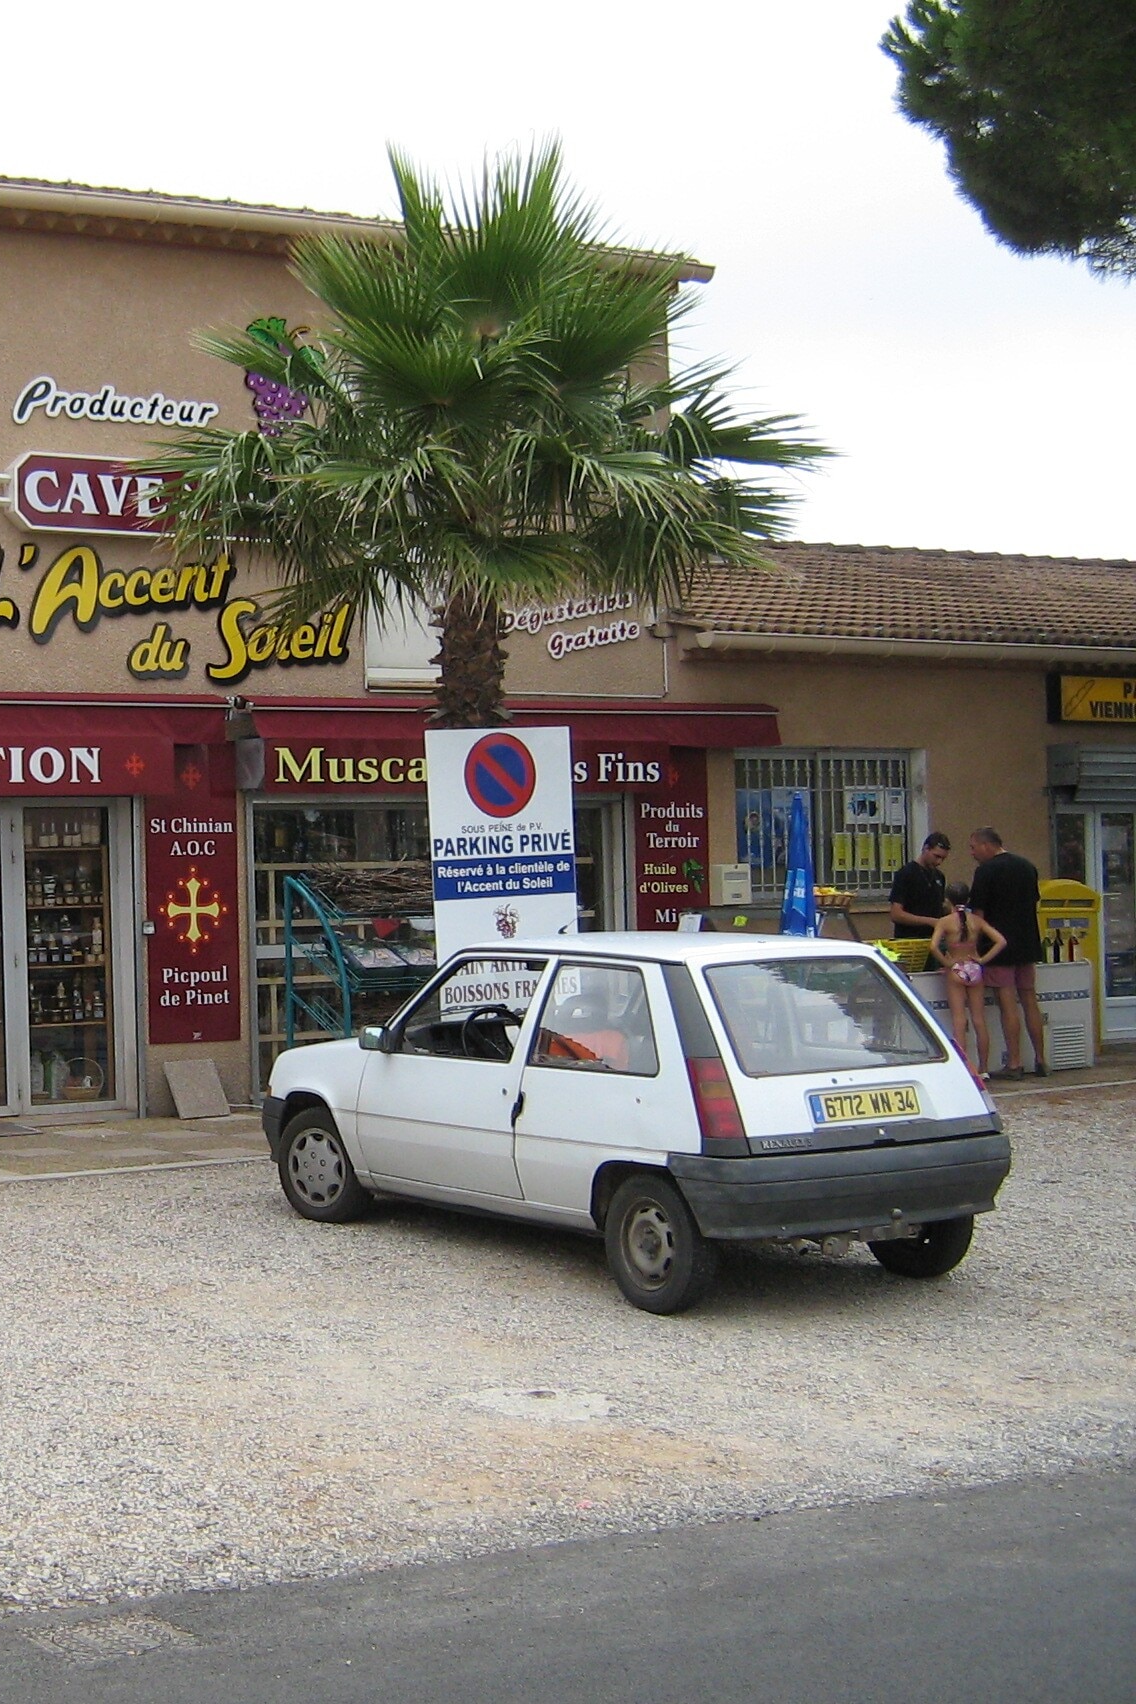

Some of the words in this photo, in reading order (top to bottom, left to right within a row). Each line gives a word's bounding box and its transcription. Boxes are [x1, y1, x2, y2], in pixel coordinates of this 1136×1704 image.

[14, 376, 218, 427] Producteur
[23, 468, 168, 519] CAVE
[207, 599, 354, 684] Soleil
[546, 619, 641, 659] Gratuite
[127, 622, 190, 682] du
[1123, 681, 1136, 699] P
[1089, 701, 1136, 719] VIENN
[274, 747, 428, 784] Musca
[597, 752, 661, 783] Fins
[640, 802, 704, 819] Produits
[150, 818, 167, 834] St
[170, 817, 233, 834] Chinian
[461, 825, 485, 834] SOUS
[665, 820, 680, 833] du
[170, 840, 216, 856] A.O.C
[433, 834, 514, 858] PARKING
[519, 829, 572, 853] PRIVÉ
[646, 832, 700, 849] Terroir
[437, 864, 484, 879] Réservé
[485, 864, 494, 876] à
[495, 863, 506, 875] la
[508, 861, 554, 874] clientèle
[556, 860, 571, 872] de
[643, 863, 677, 875] Huile
[457, 880, 504, 893] l'Accent
[505, 878, 520, 890] du
[522, 876, 554, 889] Soleil
[639, 881, 689, 894] d'Olives
[162, 966, 228, 987] Picpoul
[160, 991, 182, 1006] de
[185, 989, 230, 1006] Pinet
[444, 981, 510, 1004] BOISSONS
[824, 1094, 866, 1118] 6772
[894, 1091, 914, 1112] 34
